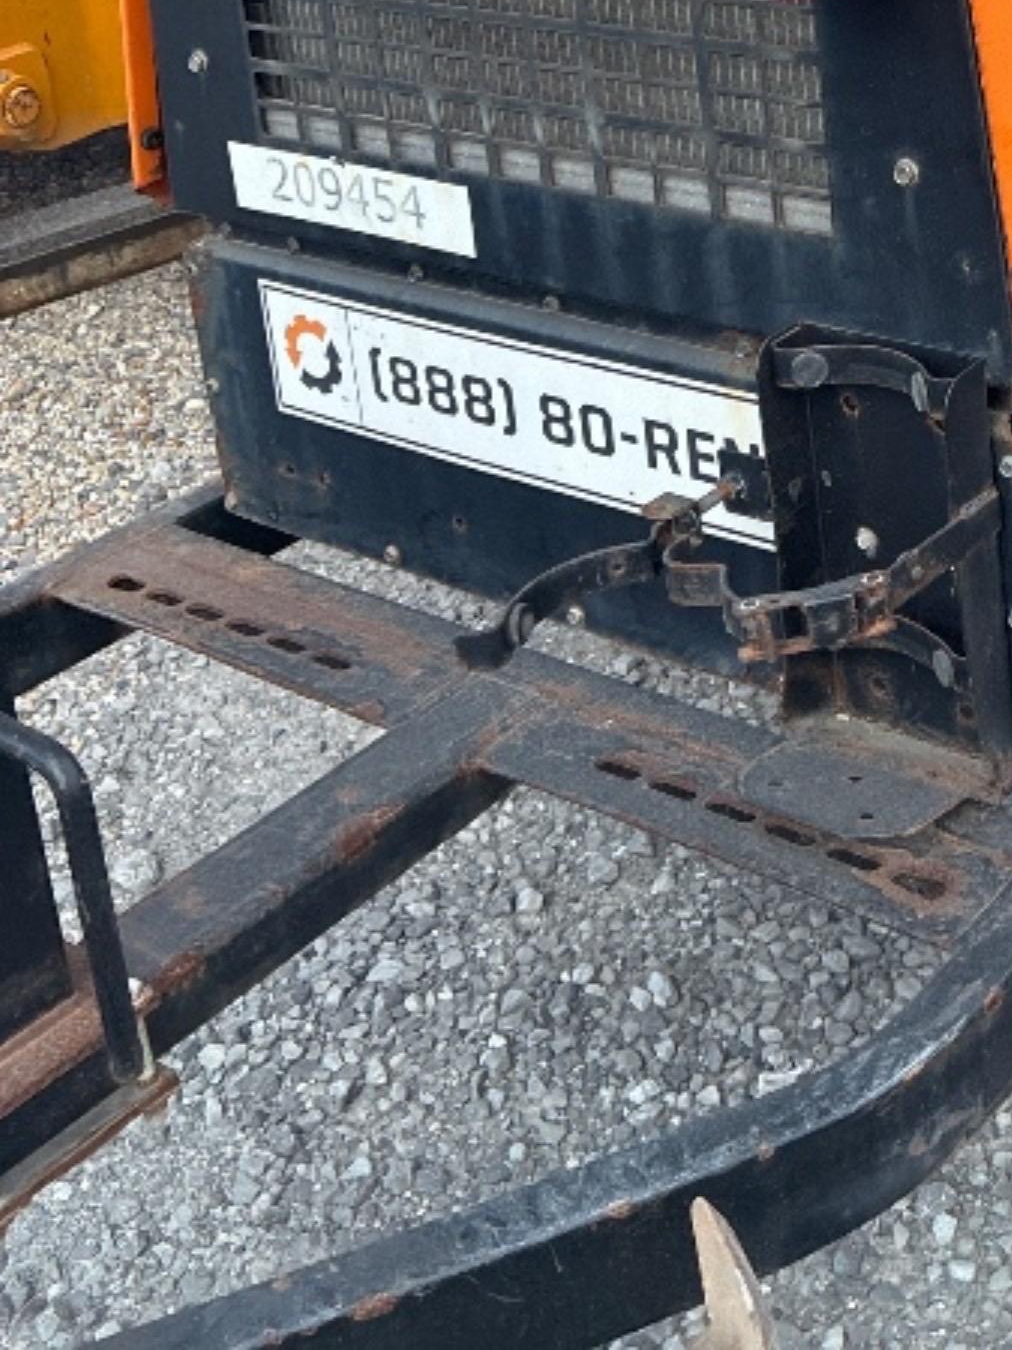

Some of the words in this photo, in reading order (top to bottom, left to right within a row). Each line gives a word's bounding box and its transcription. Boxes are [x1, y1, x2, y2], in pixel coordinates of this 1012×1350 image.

[266, 157, 426, 229] 209454
[368, 347, 517, 436] (888)
[540, 393, 760, 483] 80-RE
